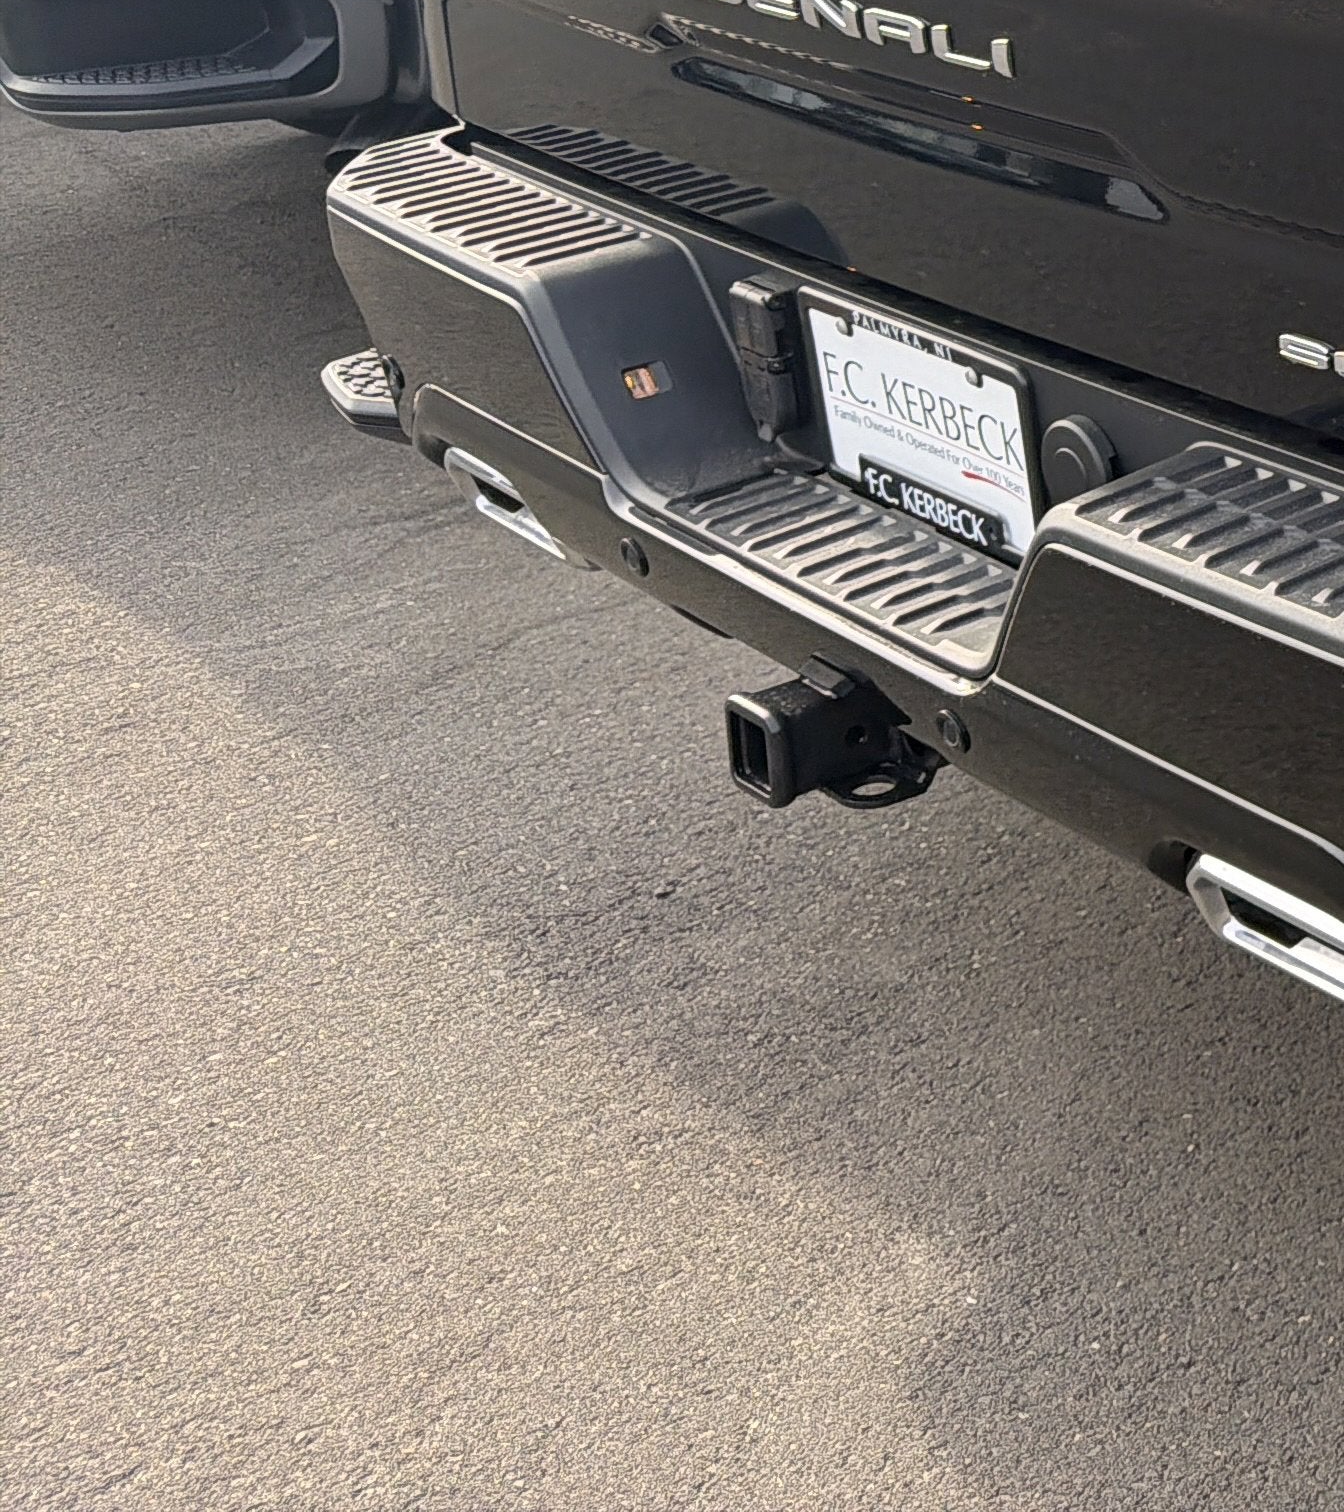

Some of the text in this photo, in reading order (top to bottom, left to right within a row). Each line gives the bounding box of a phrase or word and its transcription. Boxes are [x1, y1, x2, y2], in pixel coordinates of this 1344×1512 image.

[822, 351, 1025, 472] F.C. KERBECK
[833, 404, 862, 428] Family
[863, 415, 896, 439] Owned
[905, 431, 946, 460] Operated
[946, 448, 960, 465] For
[962, 456, 984, 475] Over
[1003, 474, 1025, 497] Years
[900, 482, 989, 547] KERBECK
